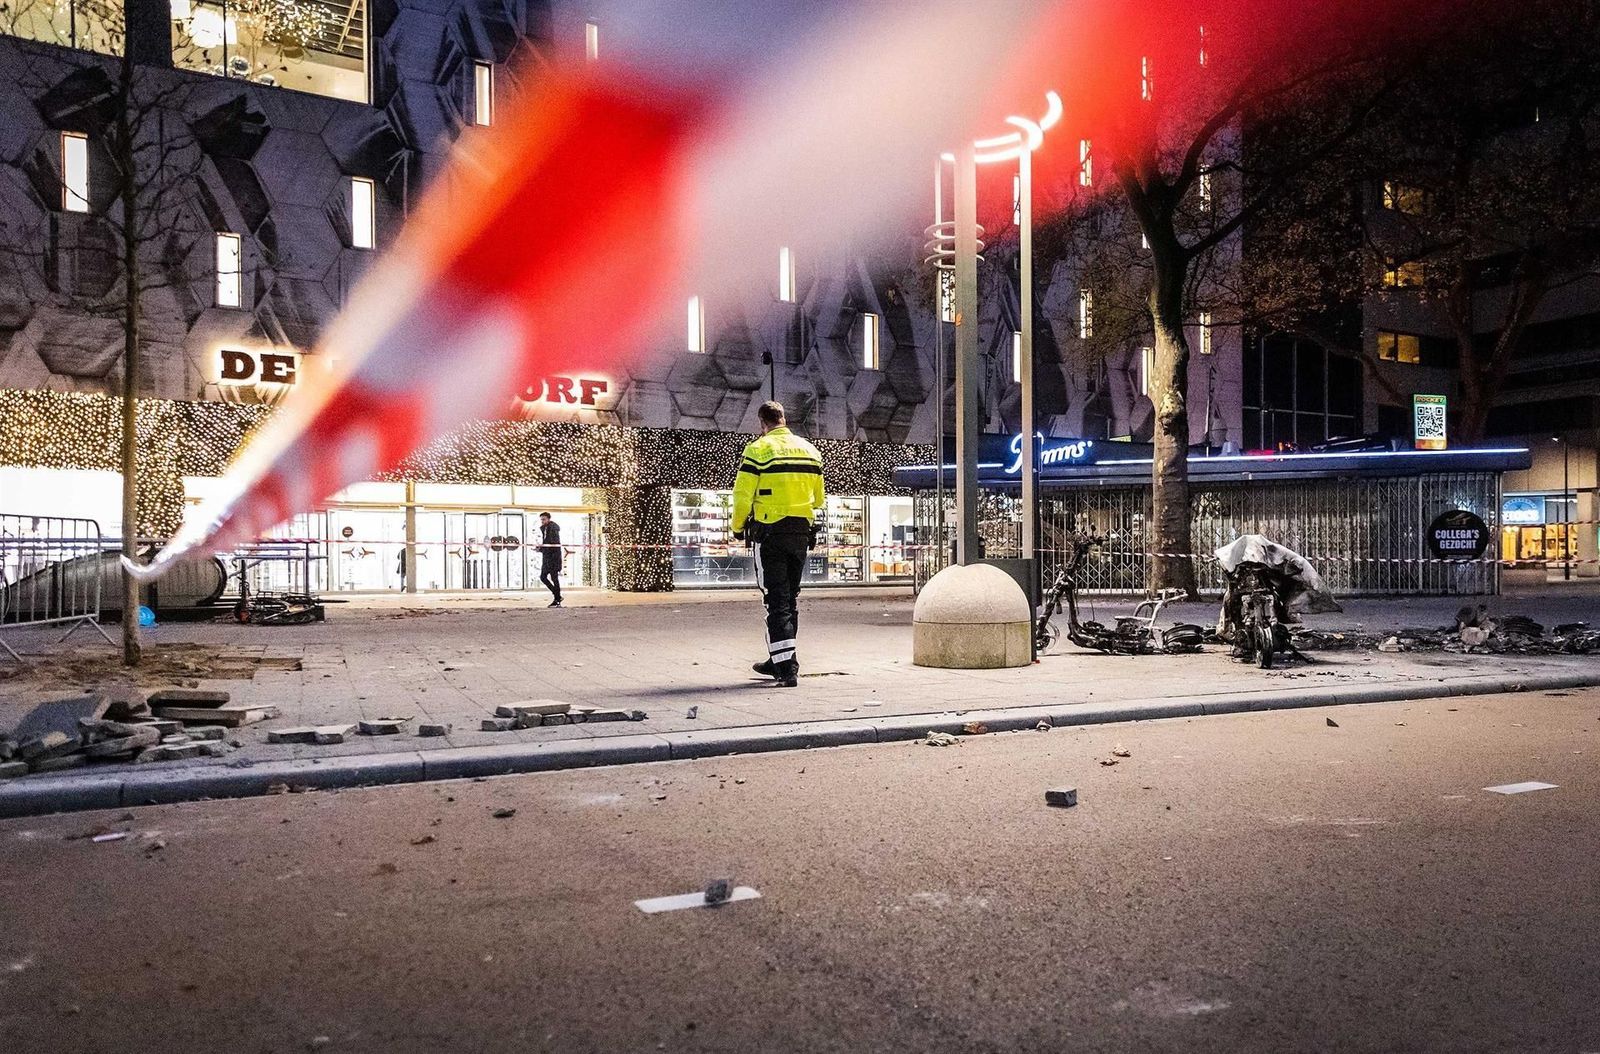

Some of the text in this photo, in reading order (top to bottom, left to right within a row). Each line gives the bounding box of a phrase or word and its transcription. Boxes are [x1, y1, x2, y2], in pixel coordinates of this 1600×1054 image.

[221, 350, 296, 384] DE
[1435, 529, 1480, 539] COLLEGA'S
[1440, 540, 1477, 549] GEZOCHT
